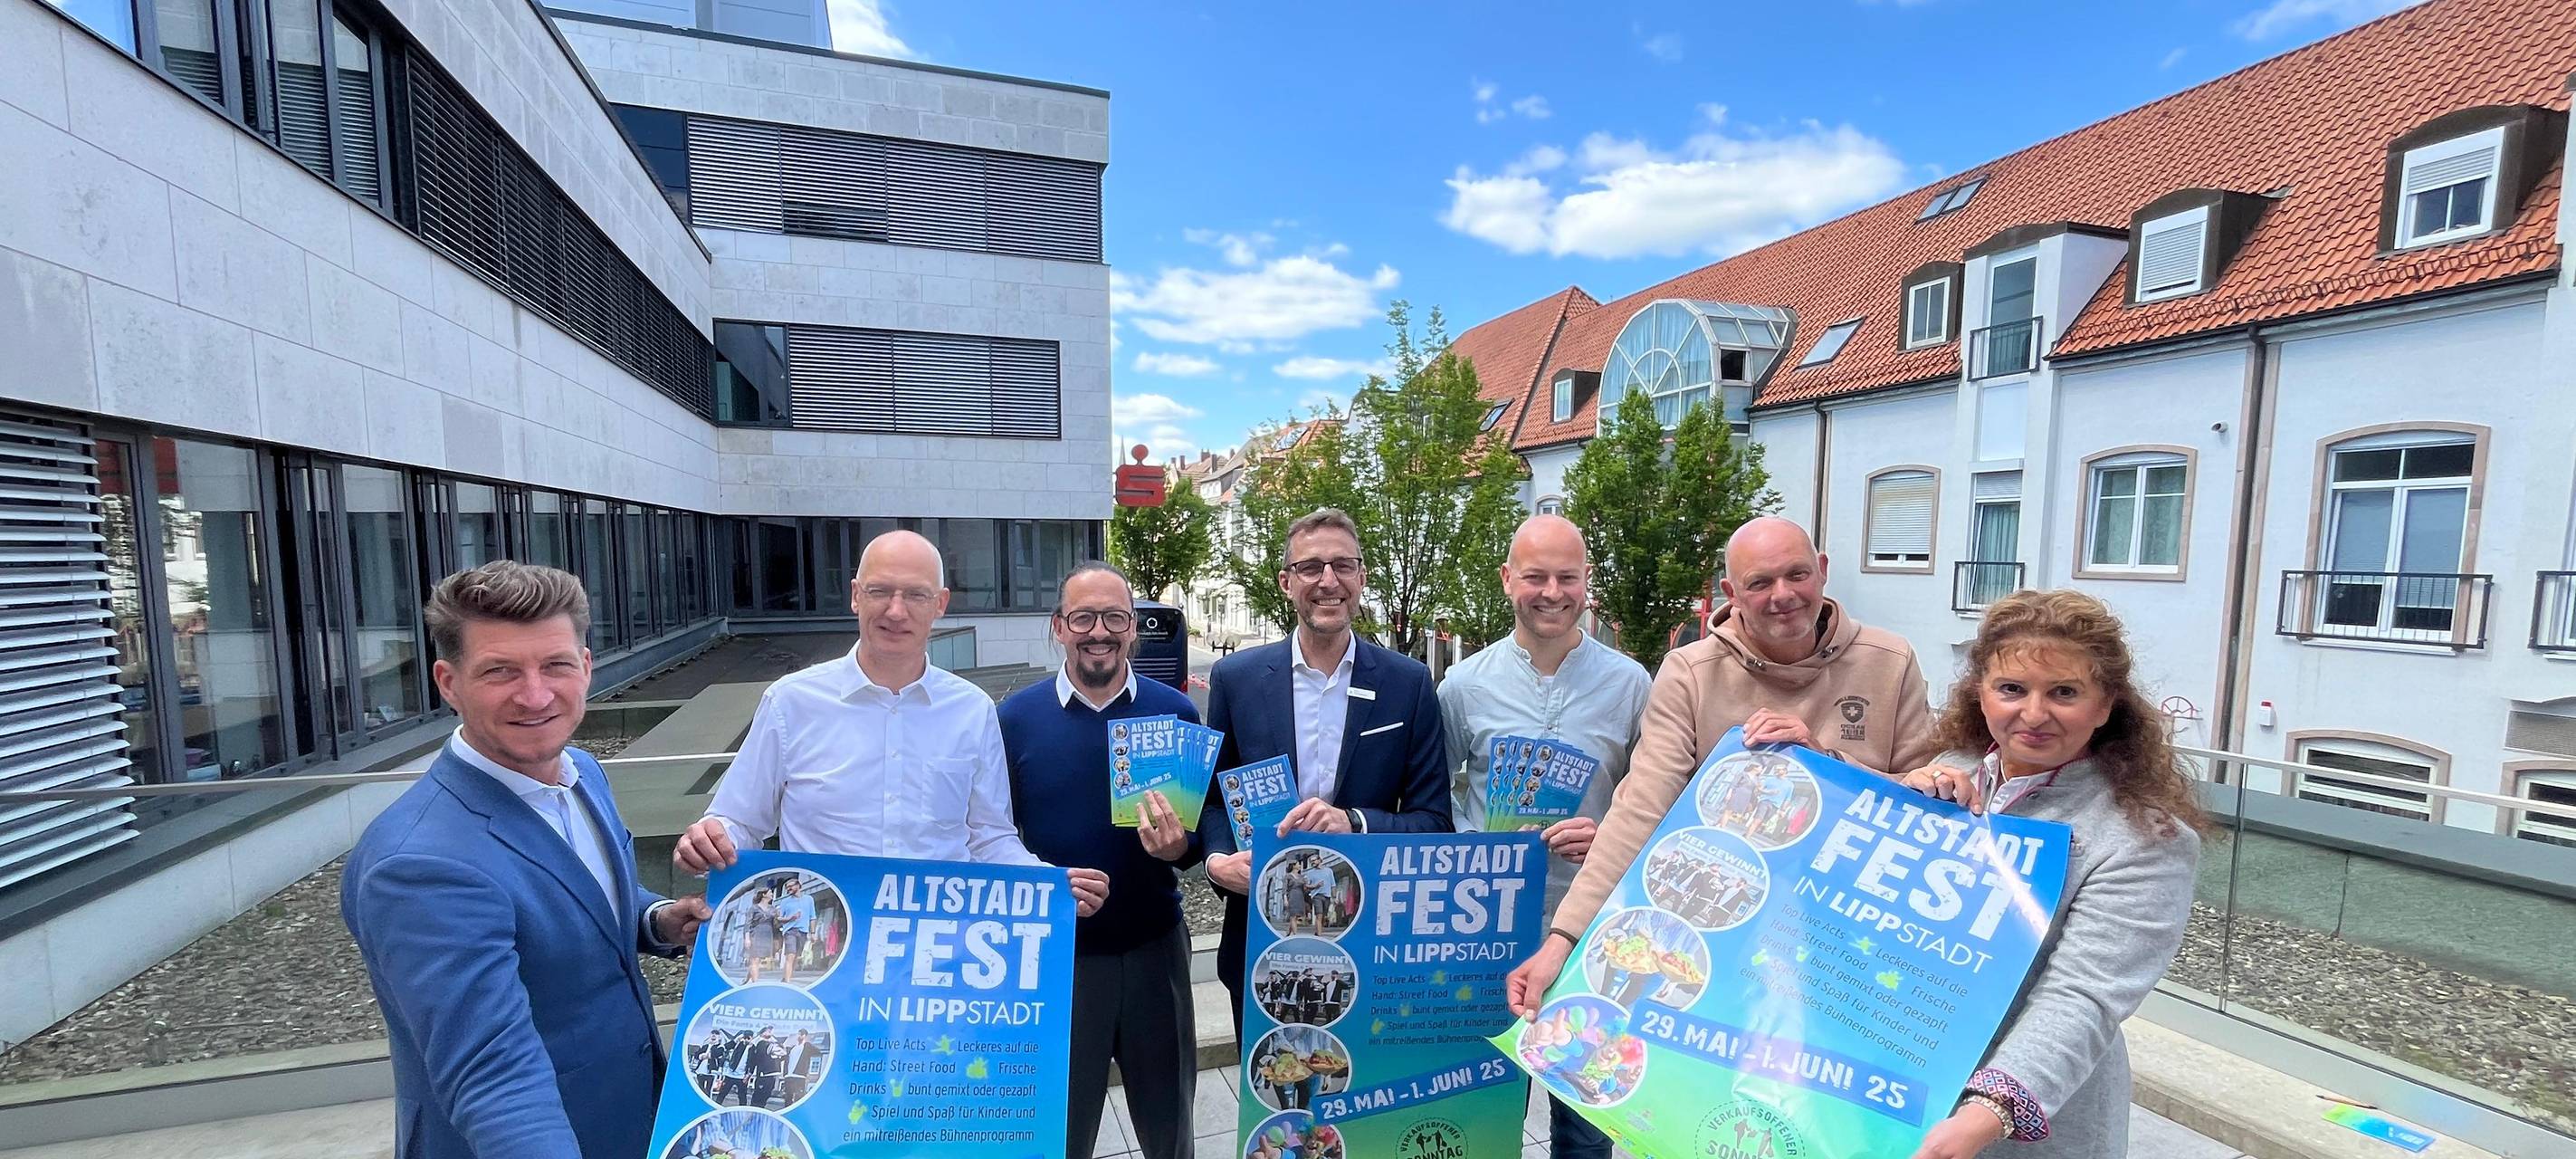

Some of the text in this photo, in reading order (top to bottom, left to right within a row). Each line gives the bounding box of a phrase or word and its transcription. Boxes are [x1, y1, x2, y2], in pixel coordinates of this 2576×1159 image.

[1131, 720, 1174, 733] ALTSTADT
[1131, 730, 1175, 751] FEST
[1141, 749, 1174, 758] LIPPSTADT
[1242, 762, 1283, 782] ALTSTADT
[1548, 761, 1590, 788] FEST
[1554, 751, 1595, 771] ALTSTADT
[1244, 773, 1287, 800] FEST
[1845, 788, 2044, 876] ALTSTADT
[1379, 843, 1529, 876] ALTSTADT
[1678, 832, 1706, 849] VIER
[1708, 846, 1767, 878] GEWINNT
[1810, 818, 2032, 942] FEST
[873, 874, 1055, 917] ALTSTADT
[1375, 877, 1526, 936] FEST
[1792, 876, 1993, 974] IN LIPPSTADT
[863, 916, 1052, 990] FEST
[1265, 952, 1349, 964] VIER GEWINNT
[1374, 942, 1518, 964] IN LIPPSTADT
[1780, 904, 1970, 998] Top Live Acts Leckeres auf die
[1373, 975, 1388, 985] Top
[1389, 975, 1407, 983] Live
[1408, 975, 1426, 984] Acts
[1449, 972, 1484, 982] Leckeres
[1485, 972, 1498, 981] auf
[1760, 934, 1949, 1034] Drinks bunt gemixt oder gezapft
[1802, 932, 1837, 956] Street
[1838, 950, 1869, 972] Food
[1911, 985, 1957, 1014] Frische
[1398, 991, 1426, 1000] Street
[1428, 990, 1448, 1000] Food
[1481, 987, 1507, 996] Frisch
[1770, 959, 1940, 1051] Spiel und Spaß für Kinder und
[709, 1003, 825, 1021] VIER GEWINNT
[859, 997, 1045, 1025] IN LIPPSTADT
[1370, 1006, 1398, 1015] Drinks
[1412, 1005, 1430, 1014] bunt
[1432, 1005, 1458, 1016] gemixt
[1461, 1003, 1478, 1012] oder
[1740, 967, 1757, 981] ein
[1824, 1001, 1928, 1069] Bühnenprogramm
[1388, 1018, 1508, 1030] Spiel und Spaß für Kinder und
[855, 1038, 1039, 1053] Top Live Acts Leckeres auf die
[852, 1059, 1036, 1075] Hand: Street Food Frische
[1640, 1011, 1679, 1041] 29.
[1684, 1023, 1739, 1060] MAI
[1761, 1044, 1775, 1069] 1.
[1779, 1052, 1855, 1091] JUNI
[1865, 1075, 1910, 1110] 25
[849, 1082, 1036, 1098] Drinks bunt gemixt oder gezapft
[1321, 1098, 1353, 1119] 29.
[1353, 1088, 1395, 1112] MAI
[1411, 1082, 1424, 1099] 1.
[1427, 1067, 1473, 1096] JUNI
[1479, 1058, 1506, 1081] 25
[871, 1105, 1035, 1121] Spiel und Spaß für Kinder und
[843, 1129, 1035, 1145] ein mitreißendes Bühnenprogramm
[1400, 1121, 1461, 1153] VERKAUFSOFFENER
[1708, 1106, 1798, 1156] VERKAUFSOFFENER
